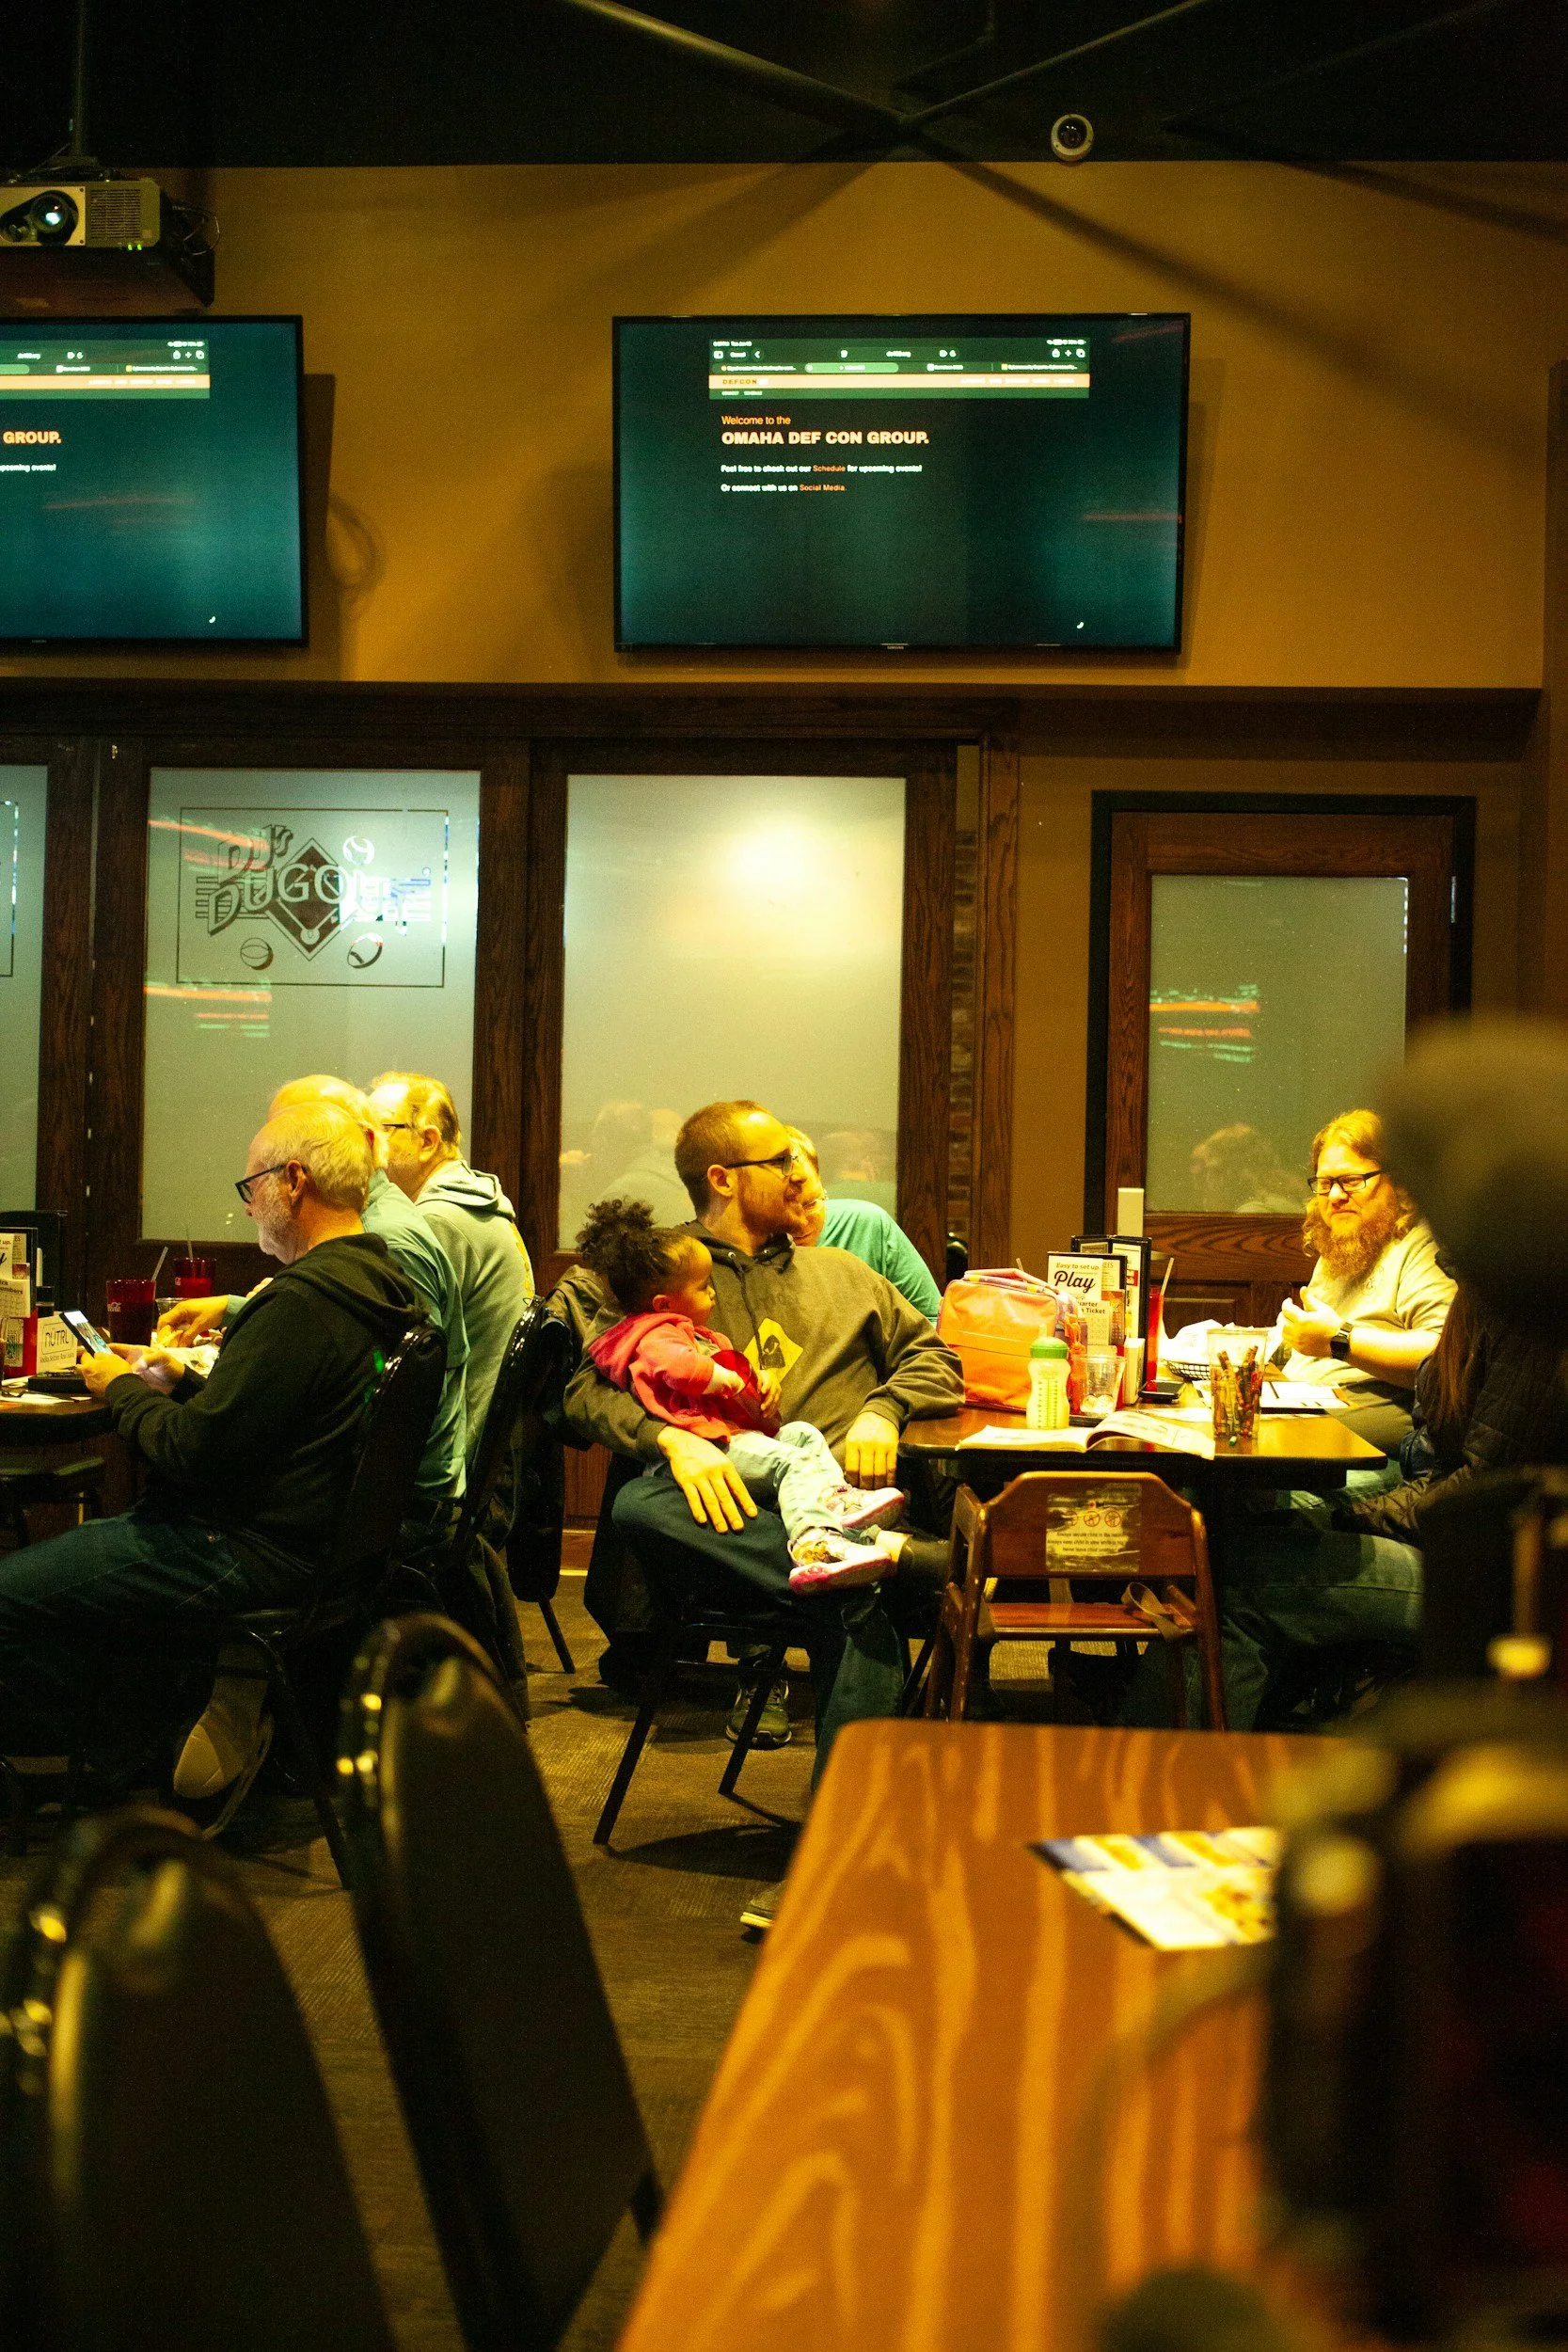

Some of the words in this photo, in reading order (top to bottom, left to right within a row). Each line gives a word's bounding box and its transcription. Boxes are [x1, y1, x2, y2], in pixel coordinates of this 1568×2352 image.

[721, 415, 764, 424] Welcome
[776, 416, 791, 424] the
[2, 430, 62, 444] GROUP.
[721, 431, 784, 444] OMAHA
[788, 431, 821, 444] DEF
[825, 431, 863, 444] CON
[867, 431, 929, 444] GROUP.
[737, 465, 752, 473] free
[753, 465, 762, 473] to
[763, 465, 784, 473] check
[785, 465, 798, 473] out
[859, 465, 895, 474] upcoming
[721, 484, 731, 492] Or
[761, 484, 777, 492] with
[1054, 1270, 1096, 1294] Play
